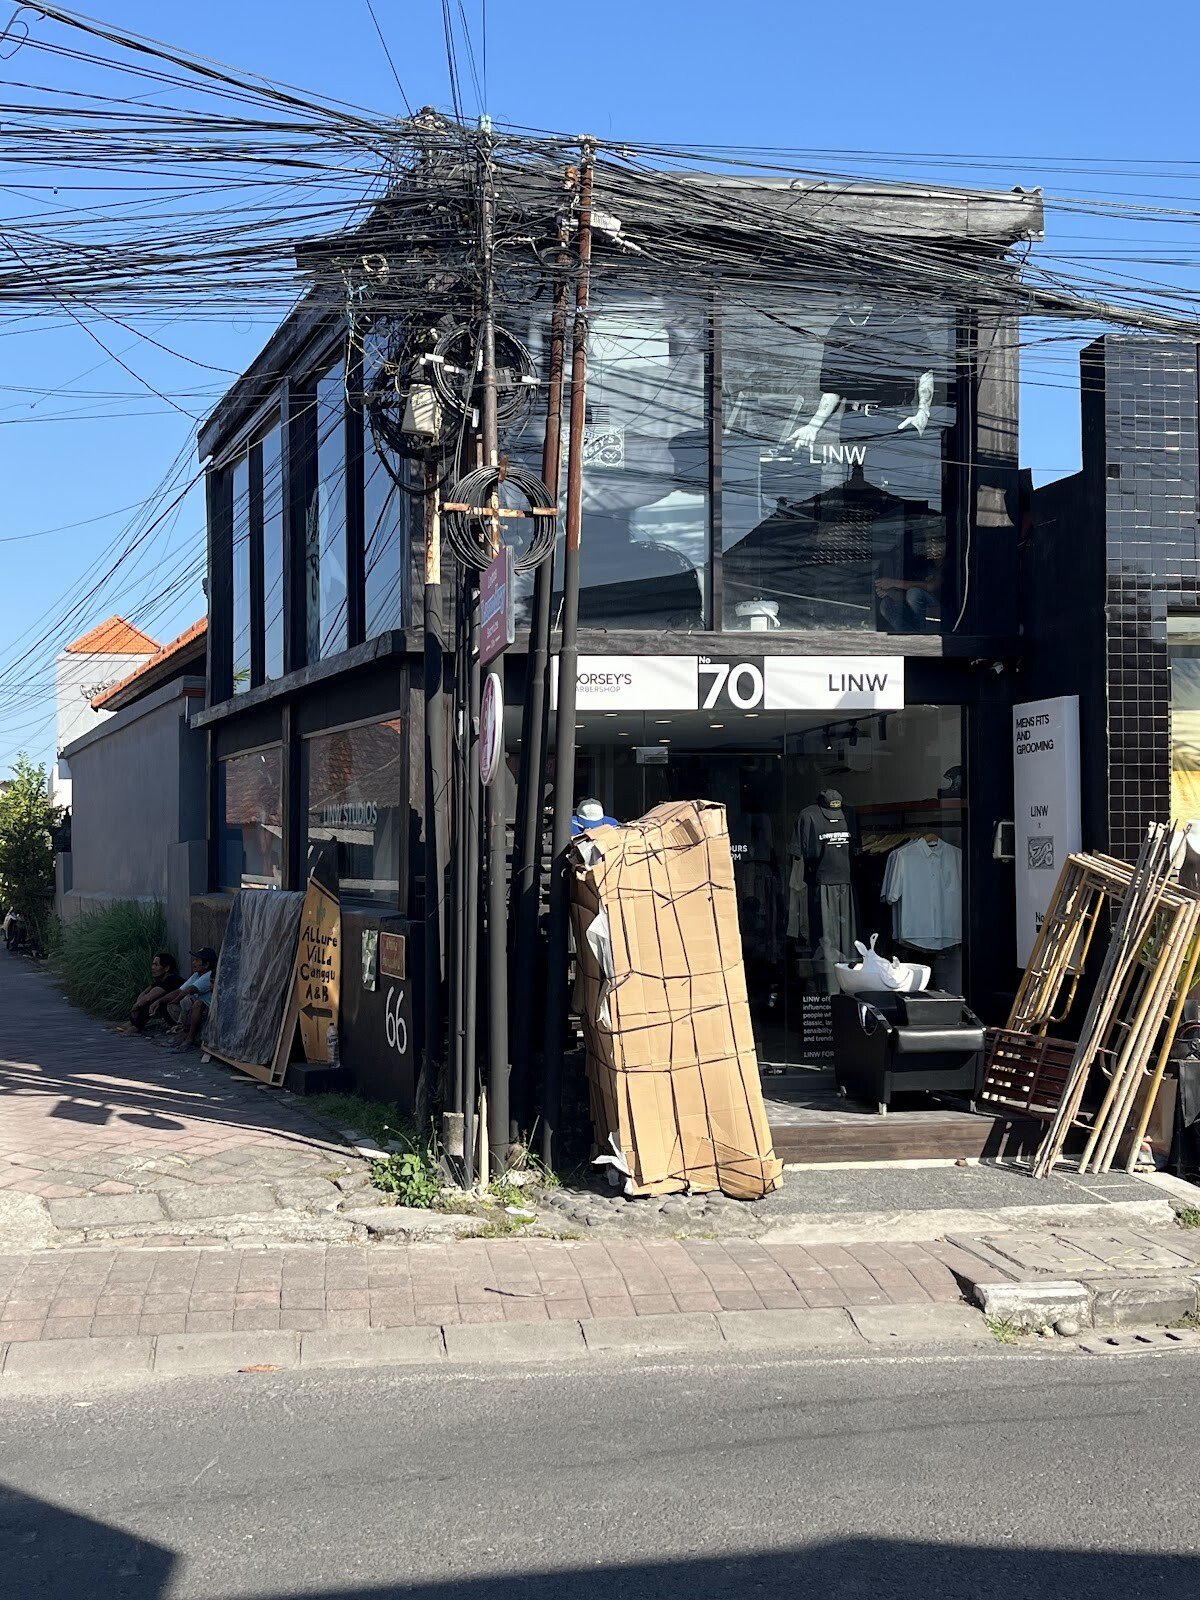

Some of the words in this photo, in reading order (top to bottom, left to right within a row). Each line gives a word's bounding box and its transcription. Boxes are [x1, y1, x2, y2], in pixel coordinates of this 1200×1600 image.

[808, 445, 867, 465] LINW
[699, 656, 711, 664] No
[577, 673, 632, 685] ORSEY'S
[829, 673, 888, 692] LINW
[575, 685, 621, 693] ARBERSHOP
[699, 663, 764, 710] 70
[1016, 730, 1031, 741] AND
[1016, 738, 1054, 755] GROOMING
[323, 803, 342, 826] LINW
[343, 800, 378, 825] STUDIOS
[1030, 805, 1049, 818] LINW
[730, 844, 748, 853] URS
[385, 985, 408, 1055] 66
[802, 1012, 823, 1020] people
